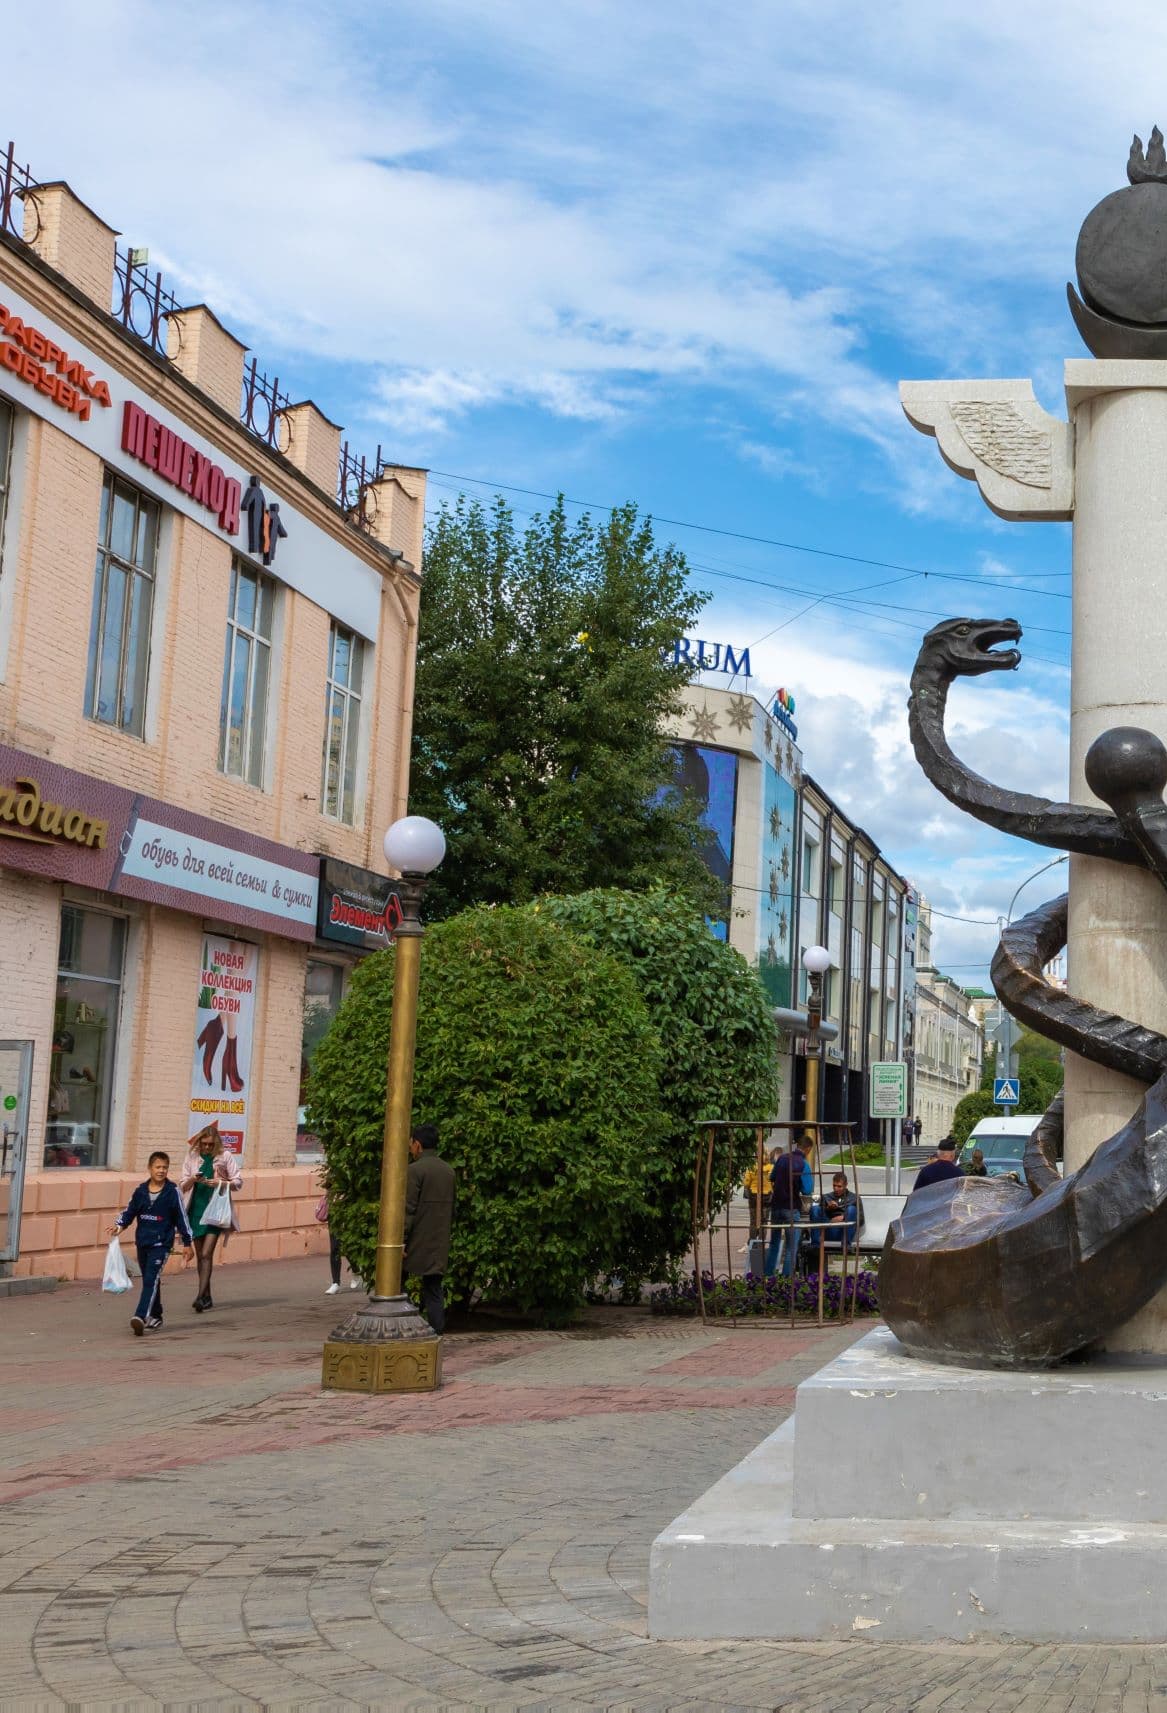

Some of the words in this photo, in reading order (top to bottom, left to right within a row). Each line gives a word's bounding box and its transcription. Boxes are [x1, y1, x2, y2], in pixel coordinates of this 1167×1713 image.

[0, 342, 91, 421] ОБУВИ
[121, 400, 241, 536] ПЕШЕХОД
[659, 636, 753, 677] RUM
[141, 838, 179, 868] обувь
[182, 848, 205, 875] для
[208, 861, 233, 883] всей
[235, 871, 267, 894] семьи
[272, 879, 281, 899] &
[283, 889, 312, 908] сумки
[214, 950, 244, 969] НОВАЯ
[201, 971, 252, 993] КОЛЛЕКЦИЯ
[211, 995, 240, 1013] ОБУВИ
